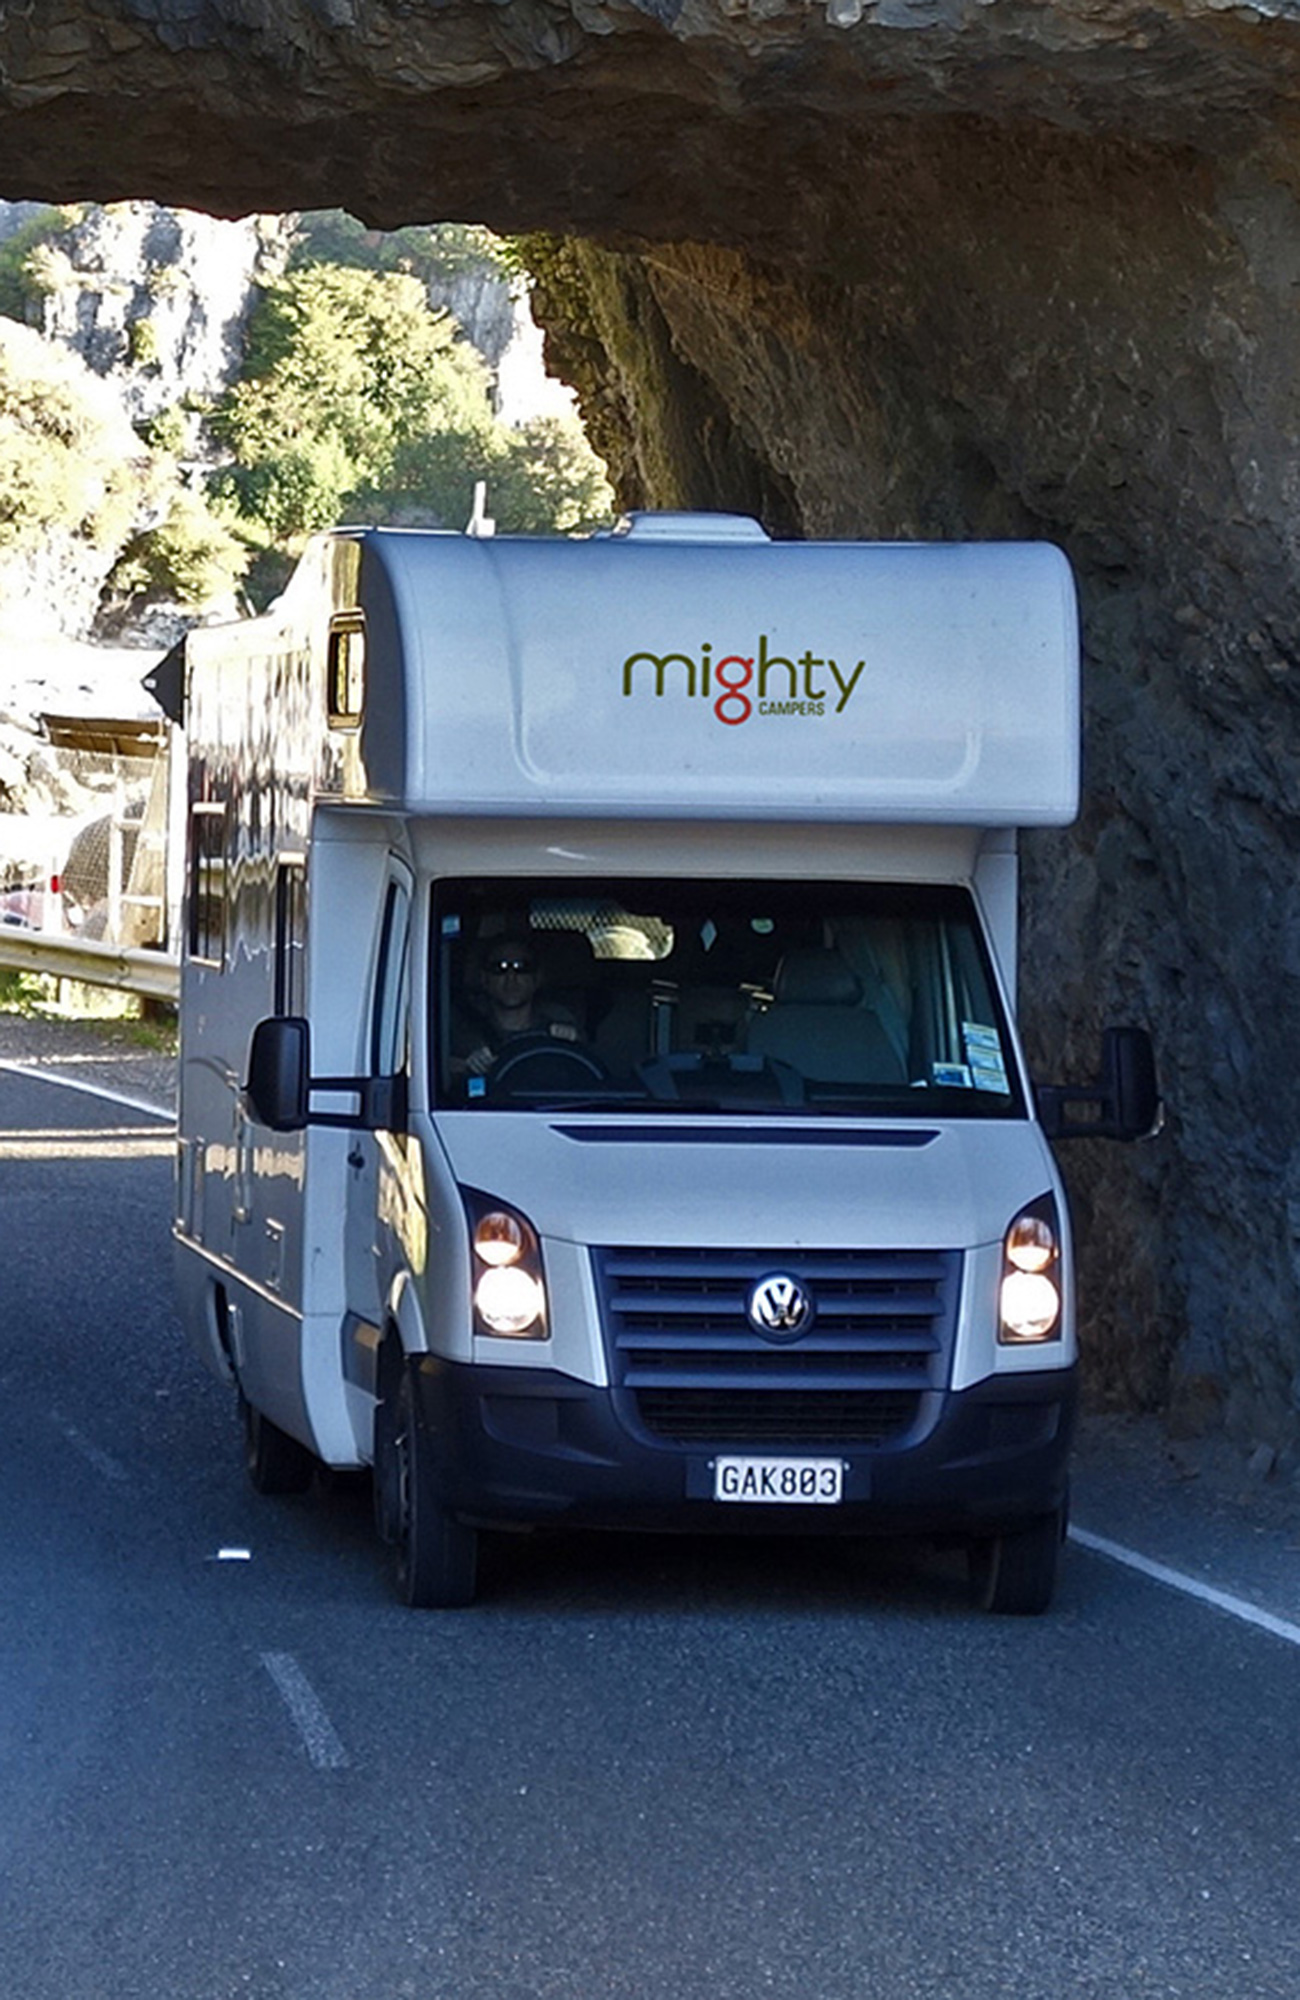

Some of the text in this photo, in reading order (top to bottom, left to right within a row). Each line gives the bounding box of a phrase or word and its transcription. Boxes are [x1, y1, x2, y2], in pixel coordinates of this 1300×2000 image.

[622, 634, 866, 726] mighty
[758, 701, 825, 716] CAMPERS
[721, 1465, 837, 1497] GAK803
